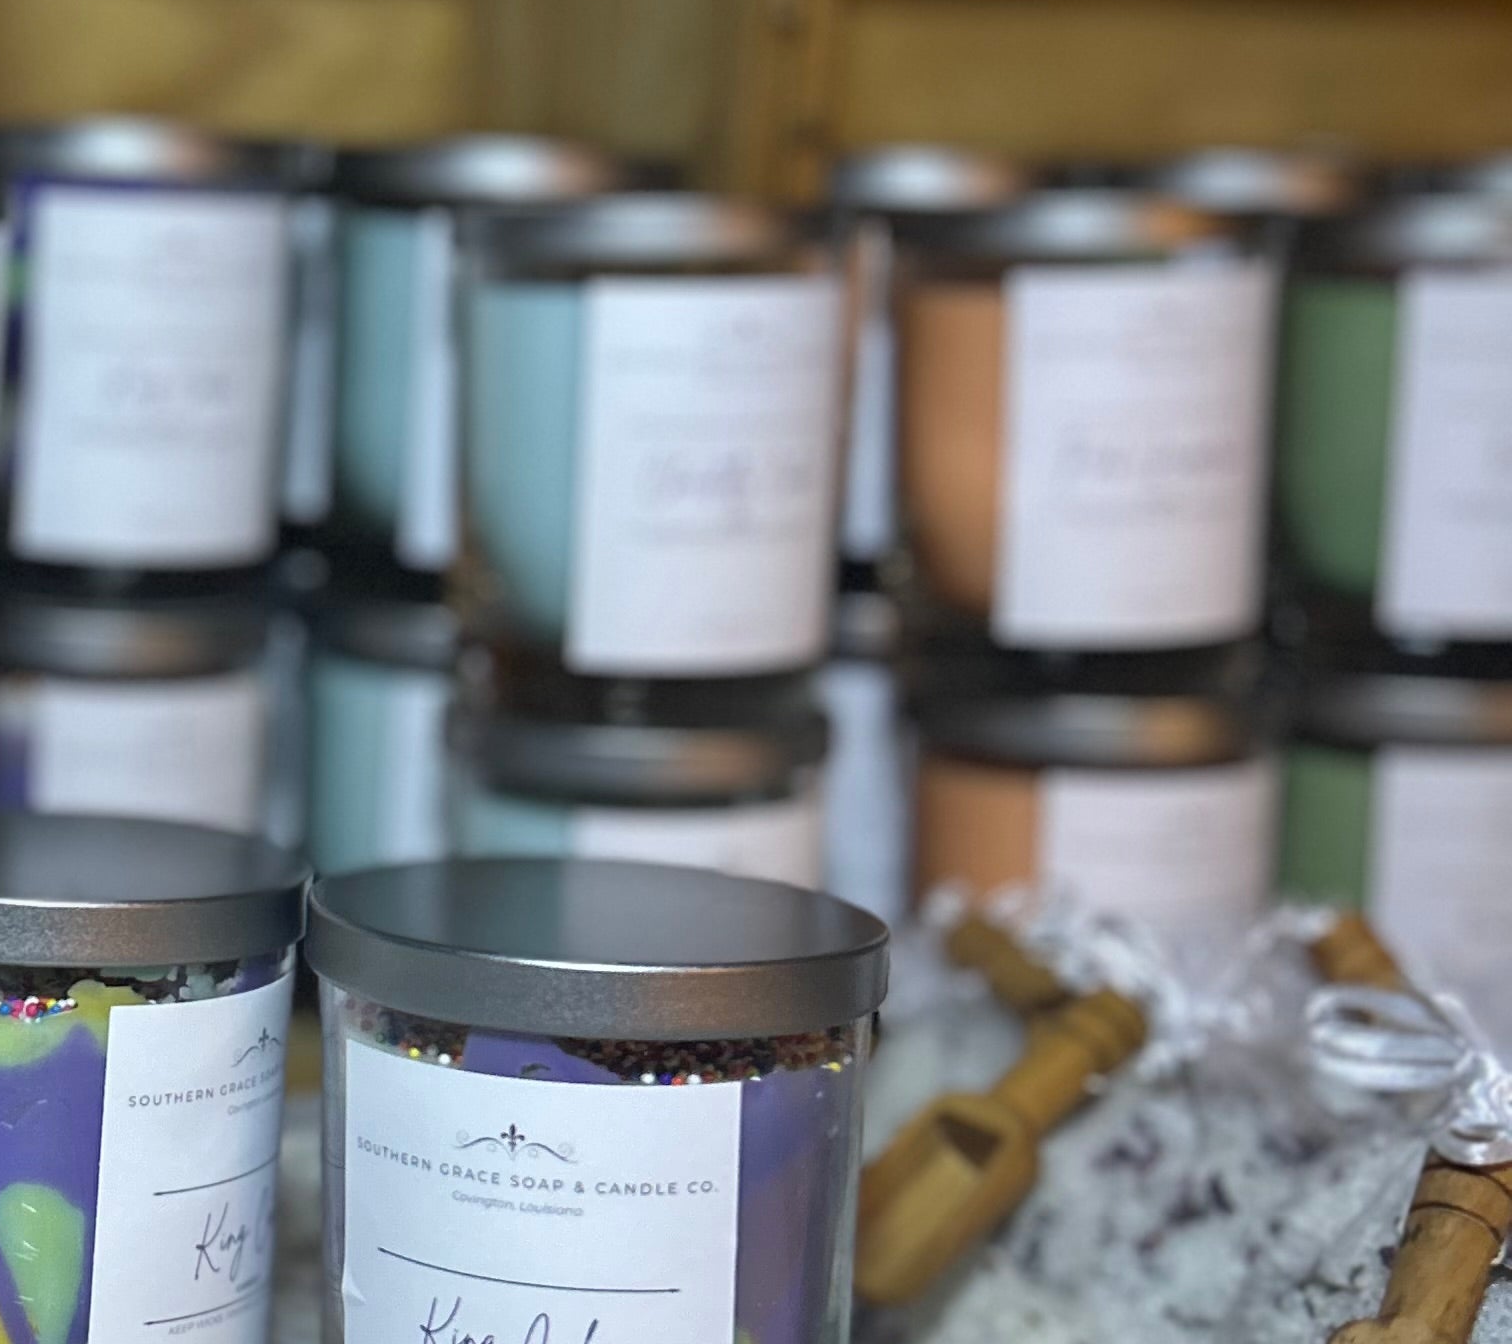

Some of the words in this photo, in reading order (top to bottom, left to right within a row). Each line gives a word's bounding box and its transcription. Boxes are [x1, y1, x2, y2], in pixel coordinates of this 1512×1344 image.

[127, 1087, 215, 1108] SOUTHERN
[219, 1075, 257, 1097] GRACE
[356, 1135, 433, 1172] SOUTHERN
[439, 1162, 501, 1186] GRACE
[510, 1174, 564, 1193] SOAP
[573, 1180, 586, 1194] &
[595, 1181, 678, 1197] CANDLE
[194, 1202, 248, 1283] King
